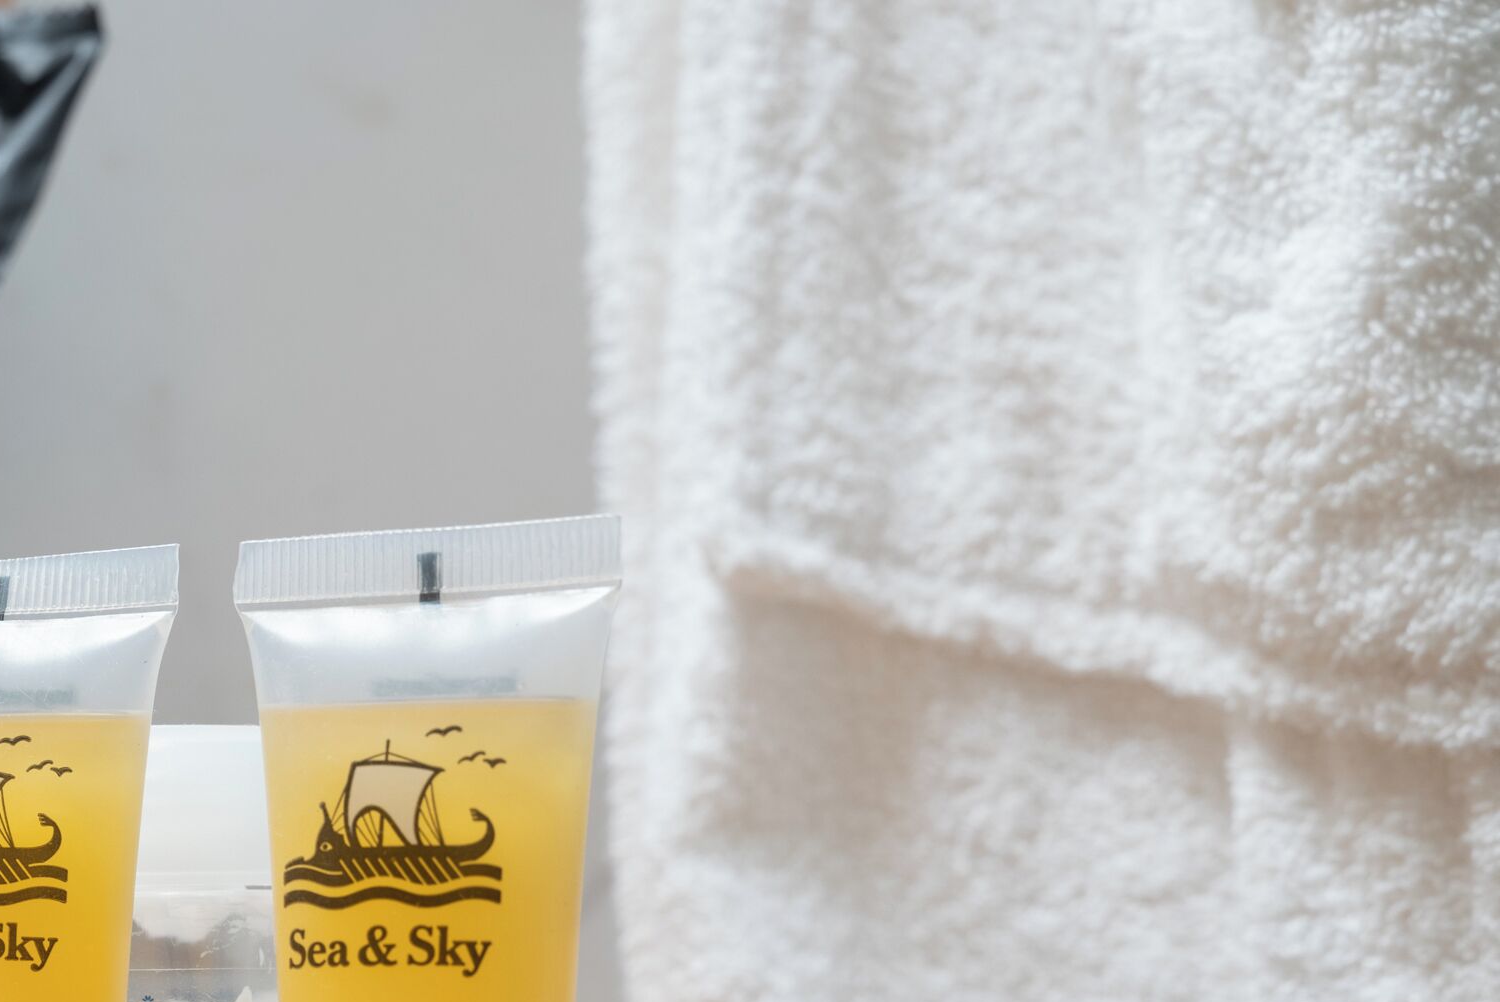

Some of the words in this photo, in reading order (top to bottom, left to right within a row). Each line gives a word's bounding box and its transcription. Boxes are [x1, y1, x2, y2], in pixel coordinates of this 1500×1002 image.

[289, 928, 350, 970] Sea
[357, 924, 398, 967] &
[406, 924, 493, 978] Sky
